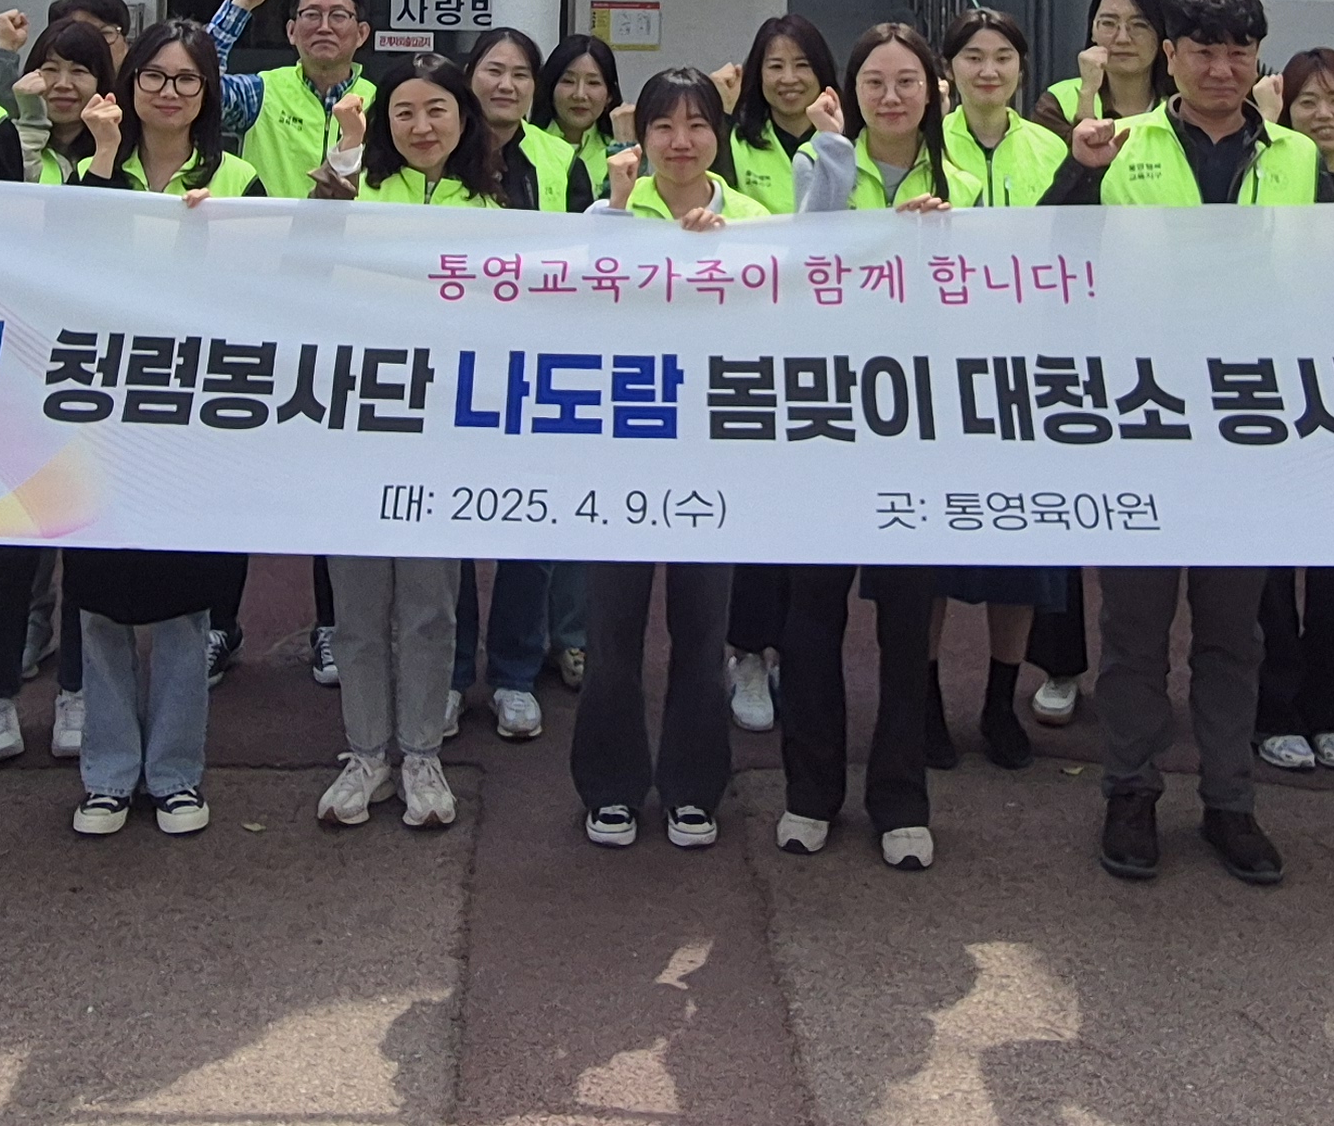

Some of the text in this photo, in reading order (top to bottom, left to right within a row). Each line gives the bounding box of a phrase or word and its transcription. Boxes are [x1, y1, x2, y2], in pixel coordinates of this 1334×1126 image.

[428, 253, 1095, 305] 통영교육가족이 함께 합니다!
[43, 328, 435, 434] 청렴봉사단
[454, 350, 684, 439] 나도람
[707, 355, 936, 442] 봄맞이
[955, 353, 1193, 445] 대청소
[380, 484, 1161, 531] 때: 2025. 4. 9.(수) 곳: 통영육아원
